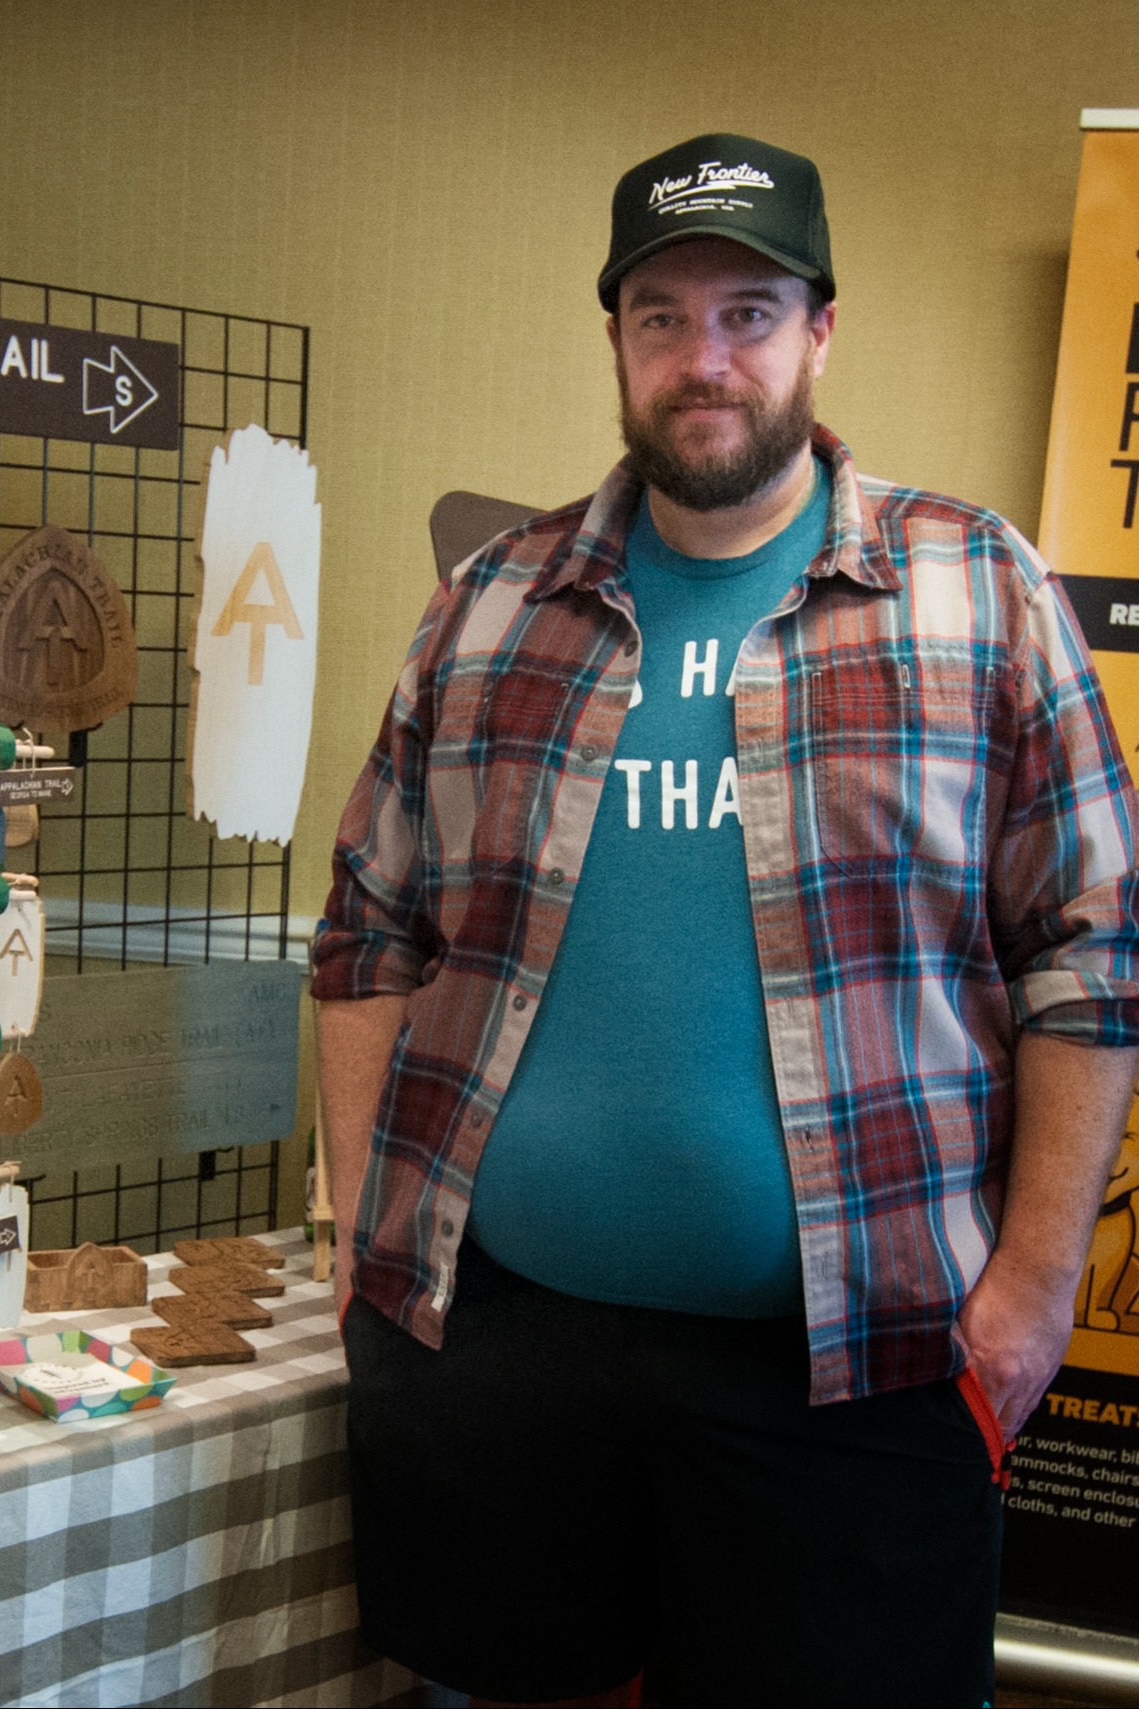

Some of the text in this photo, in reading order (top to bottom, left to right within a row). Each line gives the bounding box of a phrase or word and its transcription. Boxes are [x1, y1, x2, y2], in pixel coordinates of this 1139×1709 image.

[648, 161, 774, 205] New Frontier
[115, 375, 133, 407] S
[209, 541, 306, 686] AT
[0, 778, 63, 792] APPALACHIAN TRAIL
[1046, 1393, 1139, 1428] TREAT
[1035, 1438, 1118, 1463] workwear,
[1027, 1479, 1081, 1498] screen
[1007, 1495, 1059, 1517] cloths,
[1060, 1505, 1092, 1521] and
[1093, 1510, 1137, 1528] other
